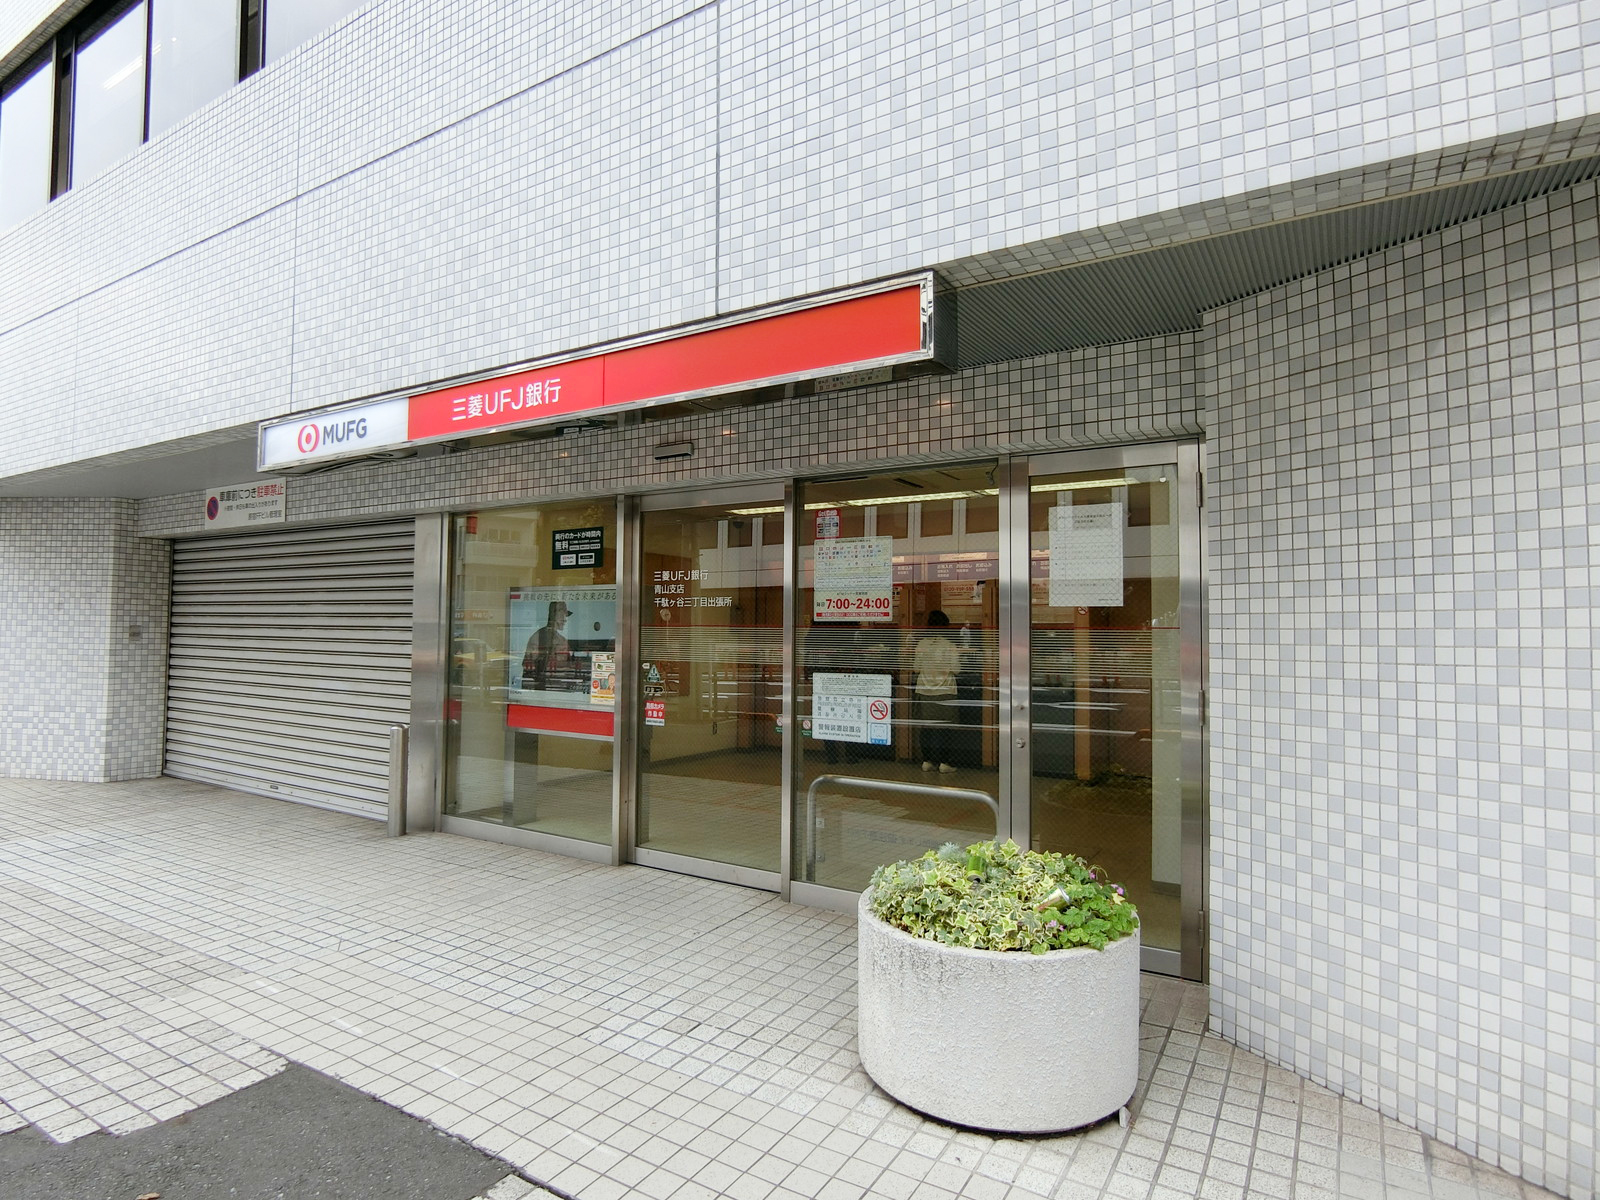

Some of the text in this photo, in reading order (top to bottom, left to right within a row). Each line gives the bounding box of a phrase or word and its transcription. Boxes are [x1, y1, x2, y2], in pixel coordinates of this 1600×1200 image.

[452, 378, 561, 421] 三菱UFJ銀行
[322, 417, 367, 445] MUFG
[654, 569, 709, 581] 三菱UFJ銀行
[654, 584, 685, 594] 青山支店
